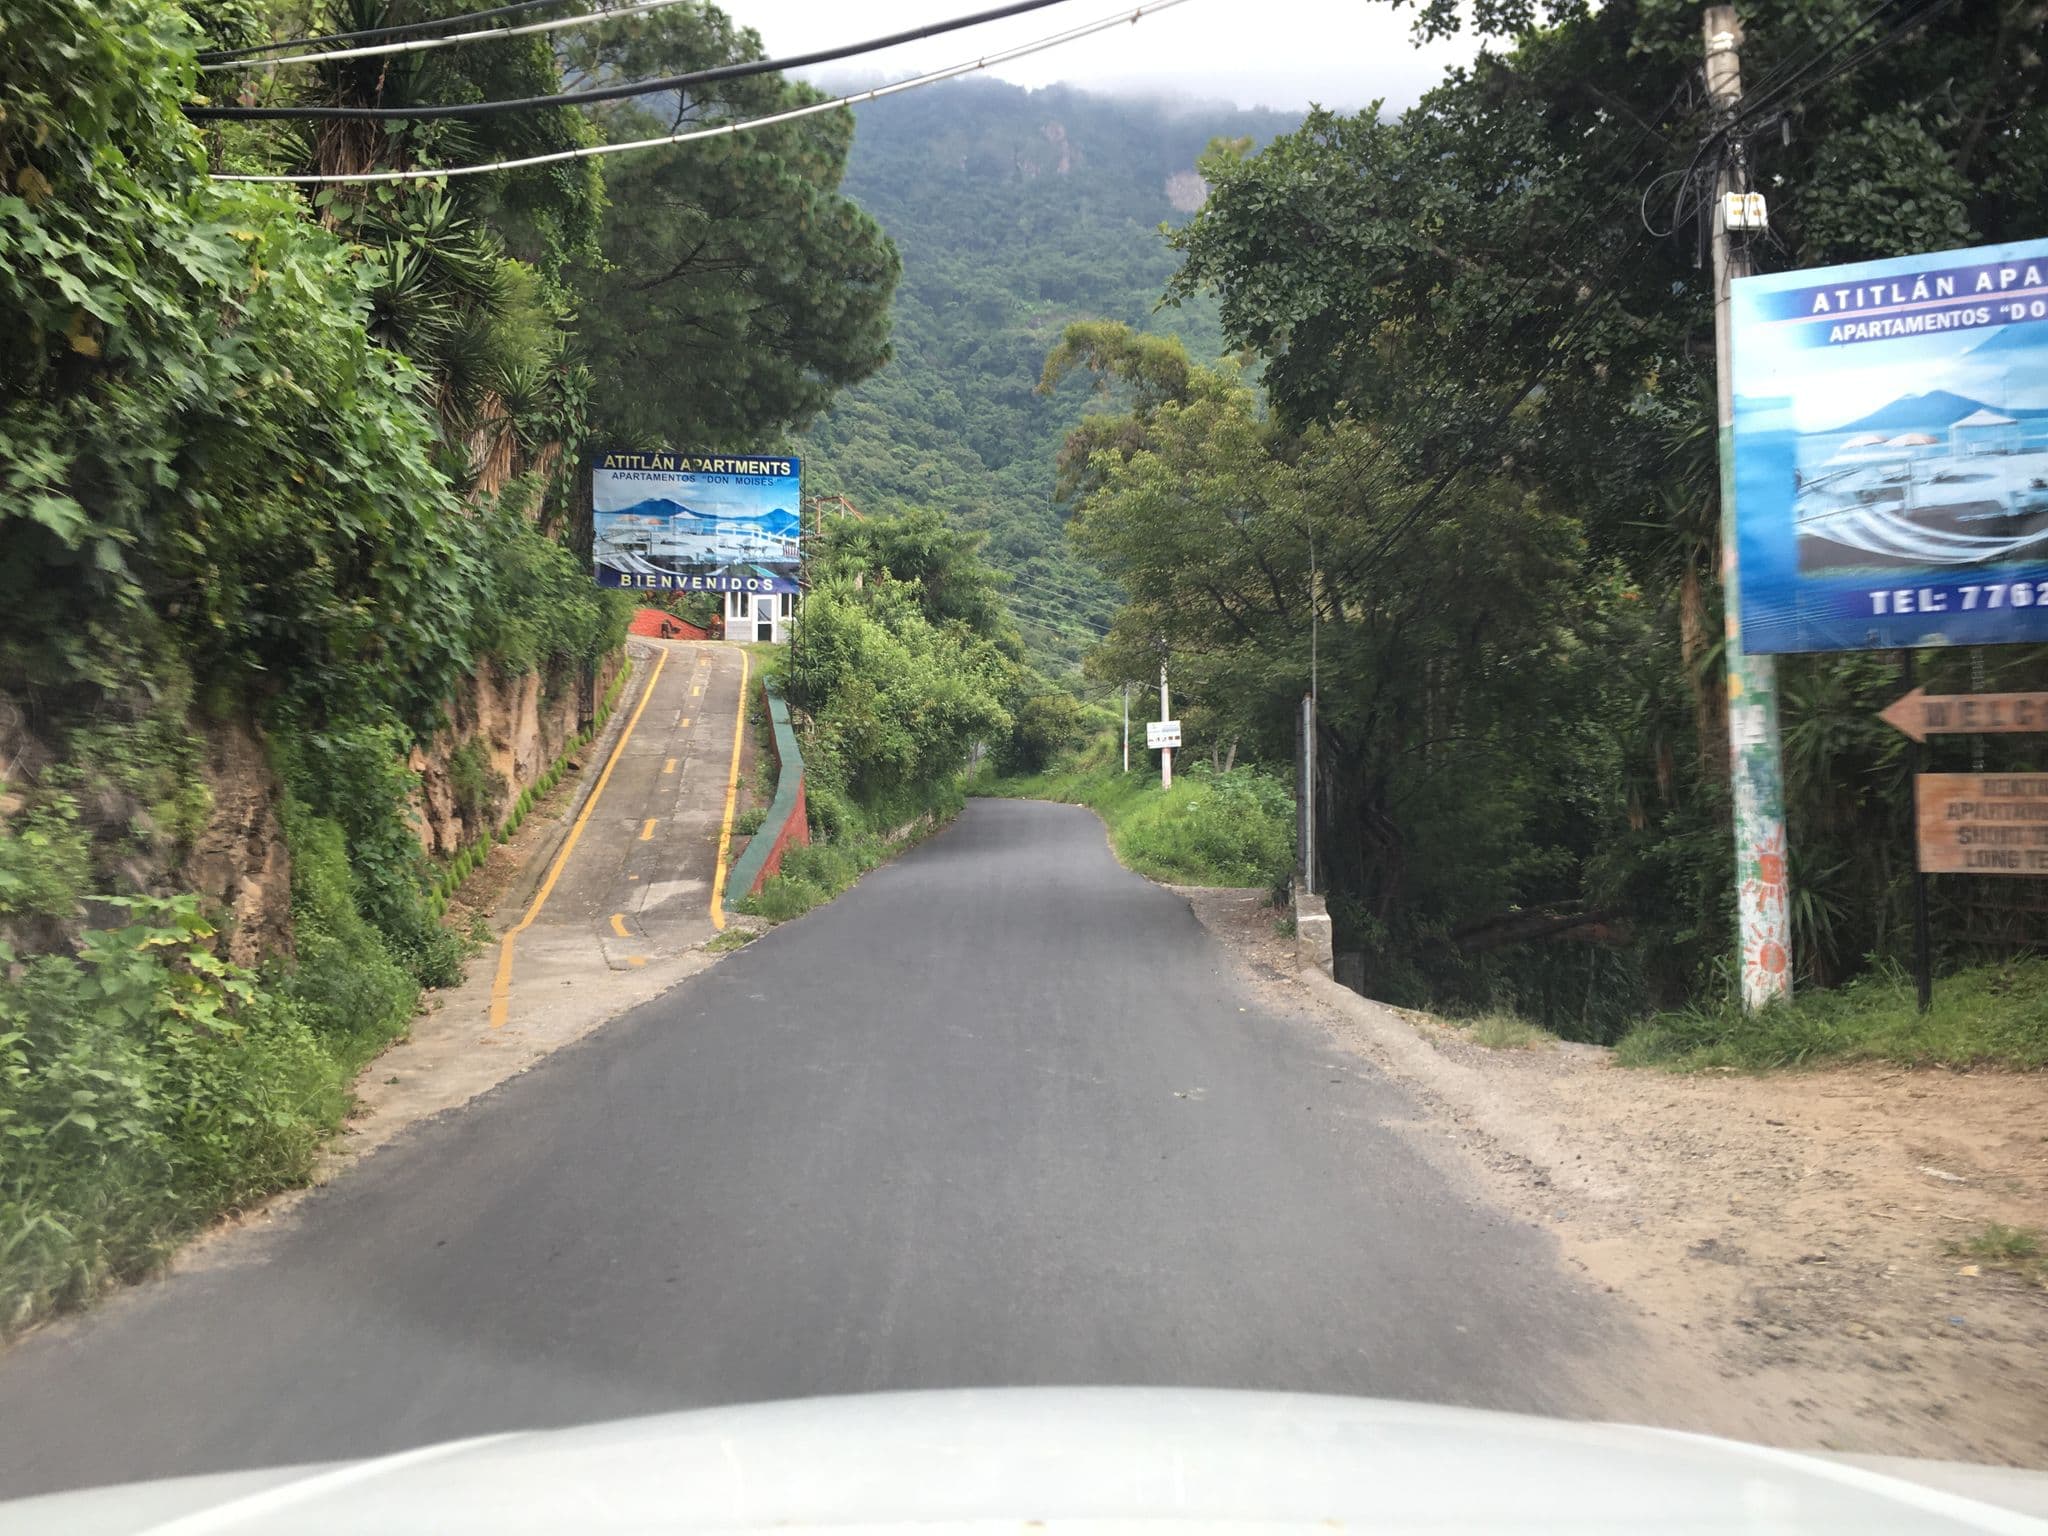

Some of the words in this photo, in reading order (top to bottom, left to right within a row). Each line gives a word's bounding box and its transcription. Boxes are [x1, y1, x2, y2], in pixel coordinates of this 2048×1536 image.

[1813, 274, 1954, 313] ATITLÁN
[1975, 265, 2042, 293] APA
[1829, 306, 1991, 343] APARTAMENTOS
[603, 453, 674, 471] ATITLÁN
[611, 472, 696, 483] APARTAMENTOS
[620, 574, 773, 591] BIENVENIDOS
[1869, 588, 1948, 615] TEL:
